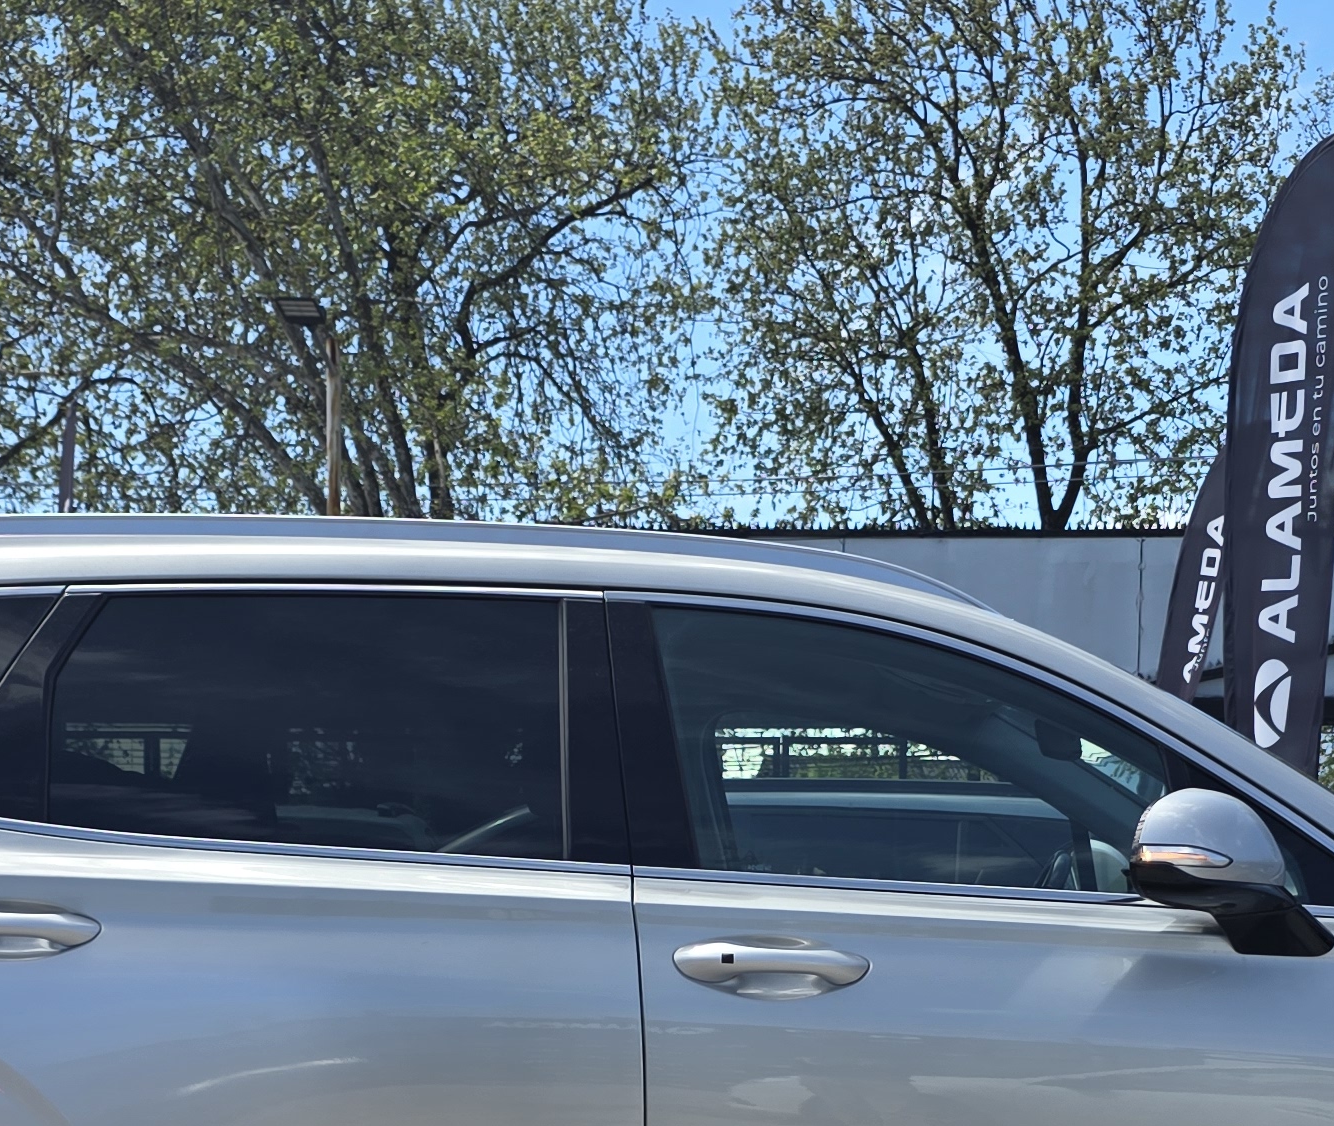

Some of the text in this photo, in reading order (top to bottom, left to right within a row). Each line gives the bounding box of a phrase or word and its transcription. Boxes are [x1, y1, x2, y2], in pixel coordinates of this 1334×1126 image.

[1258, 282, 1310, 644] ALAMEDA
[1307, 275, 1329, 522] Juntos en tu camino
